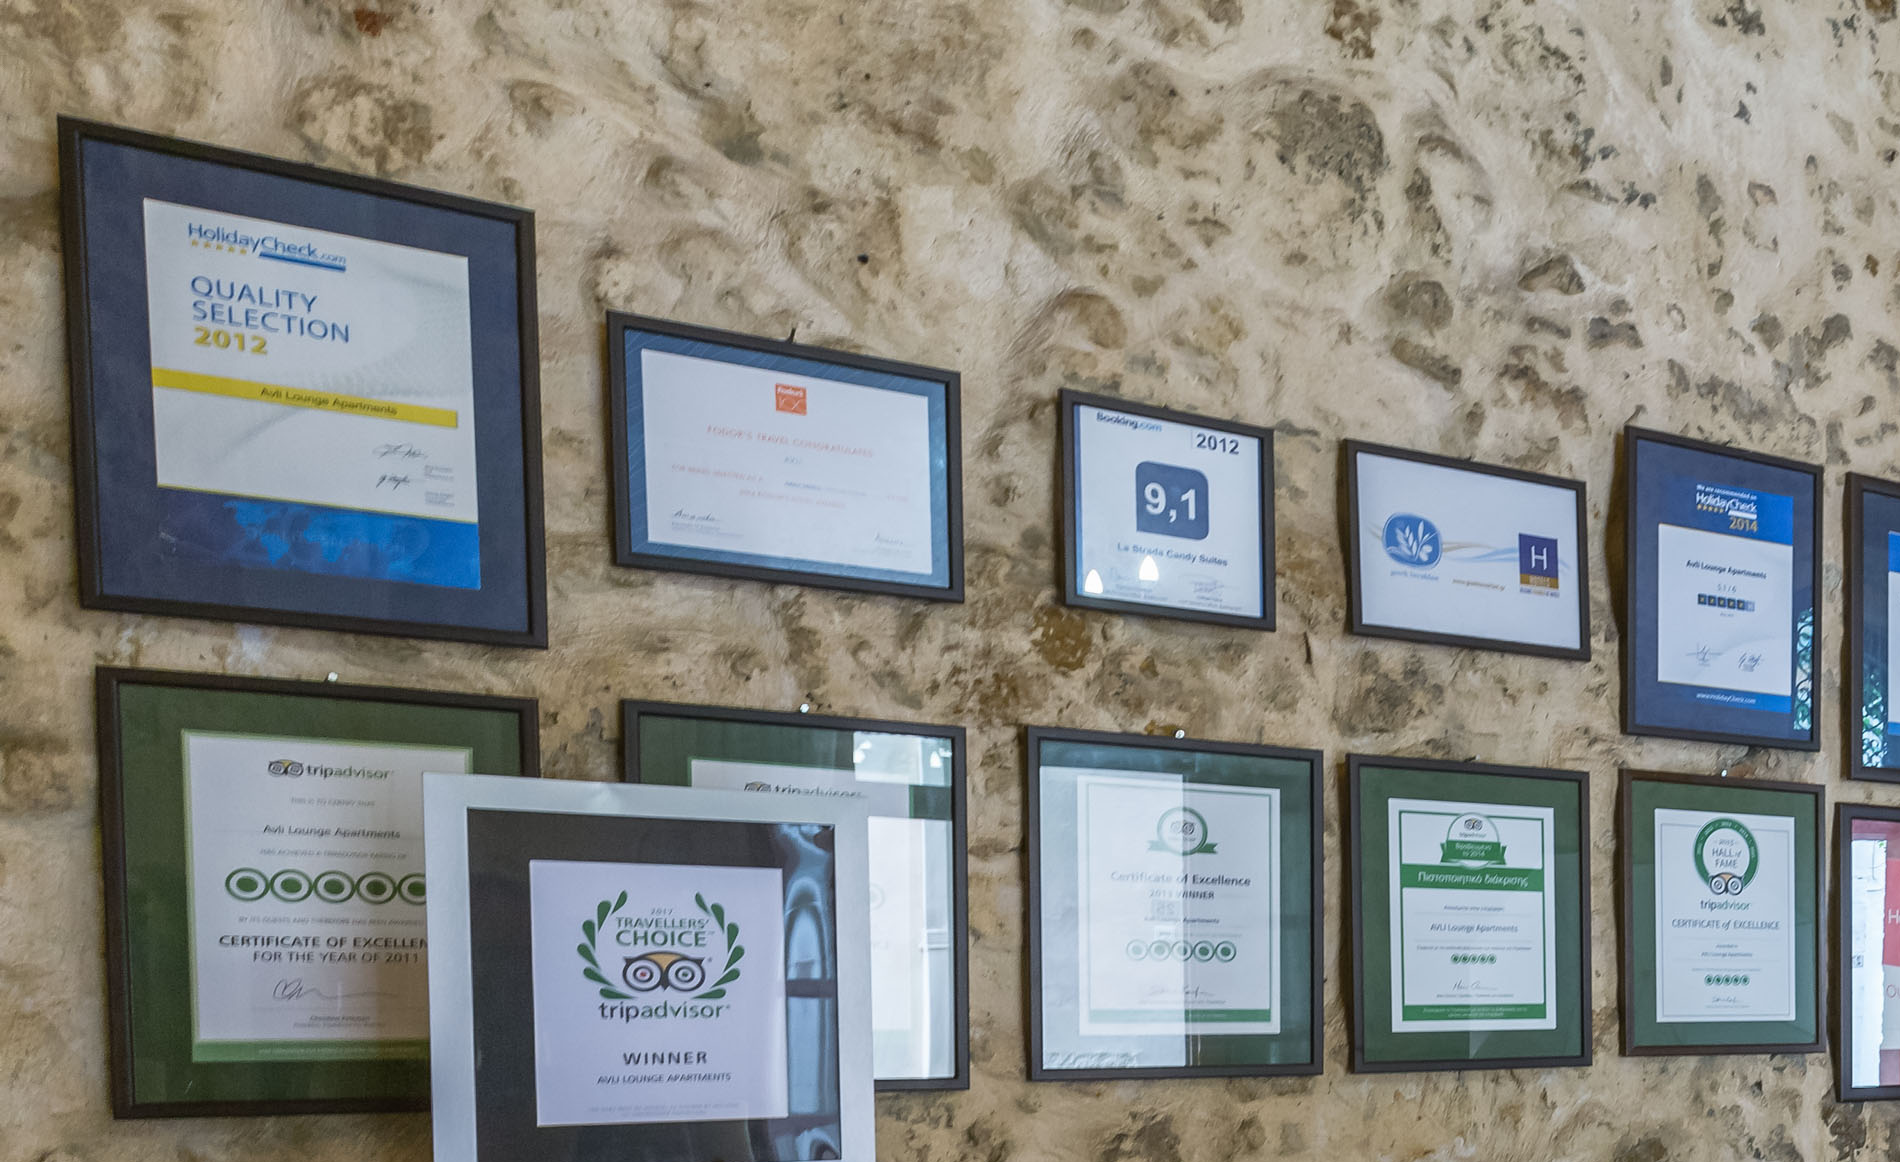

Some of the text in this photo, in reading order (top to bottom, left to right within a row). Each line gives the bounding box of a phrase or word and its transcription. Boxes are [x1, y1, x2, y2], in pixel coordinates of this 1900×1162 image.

[191, 275, 317, 313] QUALITY
[192, 300, 349, 343] SELECTION
[193, 326, 267, 355] 2012
[286, 390, 329, 407] Lounge
[332, 398, 398, 417] Apartments
[1196, 433, 1240, 455] 2012
[1143, 482, 1196, 523] 9,1
[1729, 516, 1758, 532] 2014
[307, 764, 391, 779] tripadvisor
[263, 824, 400, 839] Avli Lounge Apartments
[1712, 847, 1734, 858] HALL
[1714, 858, 1738, 869] FAME
[1111, 871, 1173, 884] Certificate
[1192, 874, 1251, 886] Excellence
[1700, 899, 1751, 912] tripadvisor
[616, 916, 710, 929] TRAVELLERS'
[1671, 918, 1720, 929] CERTIFICATE
[1733, 920, 1781, 930] EXCELLENCE
[219, 935, 320, 948] CERTIFICATE
[326, 936, 350, 949] OF
[616, 930, 707, 947] CHOICE
[253, 951, 418, 964] FOR THE YEAR OF 2011
[599, 1000, 722, 1024] tripadvisor
[623, 1052, 707, 1065] WINNER
[667, 1072, 732, 1082] APARTMENTS
